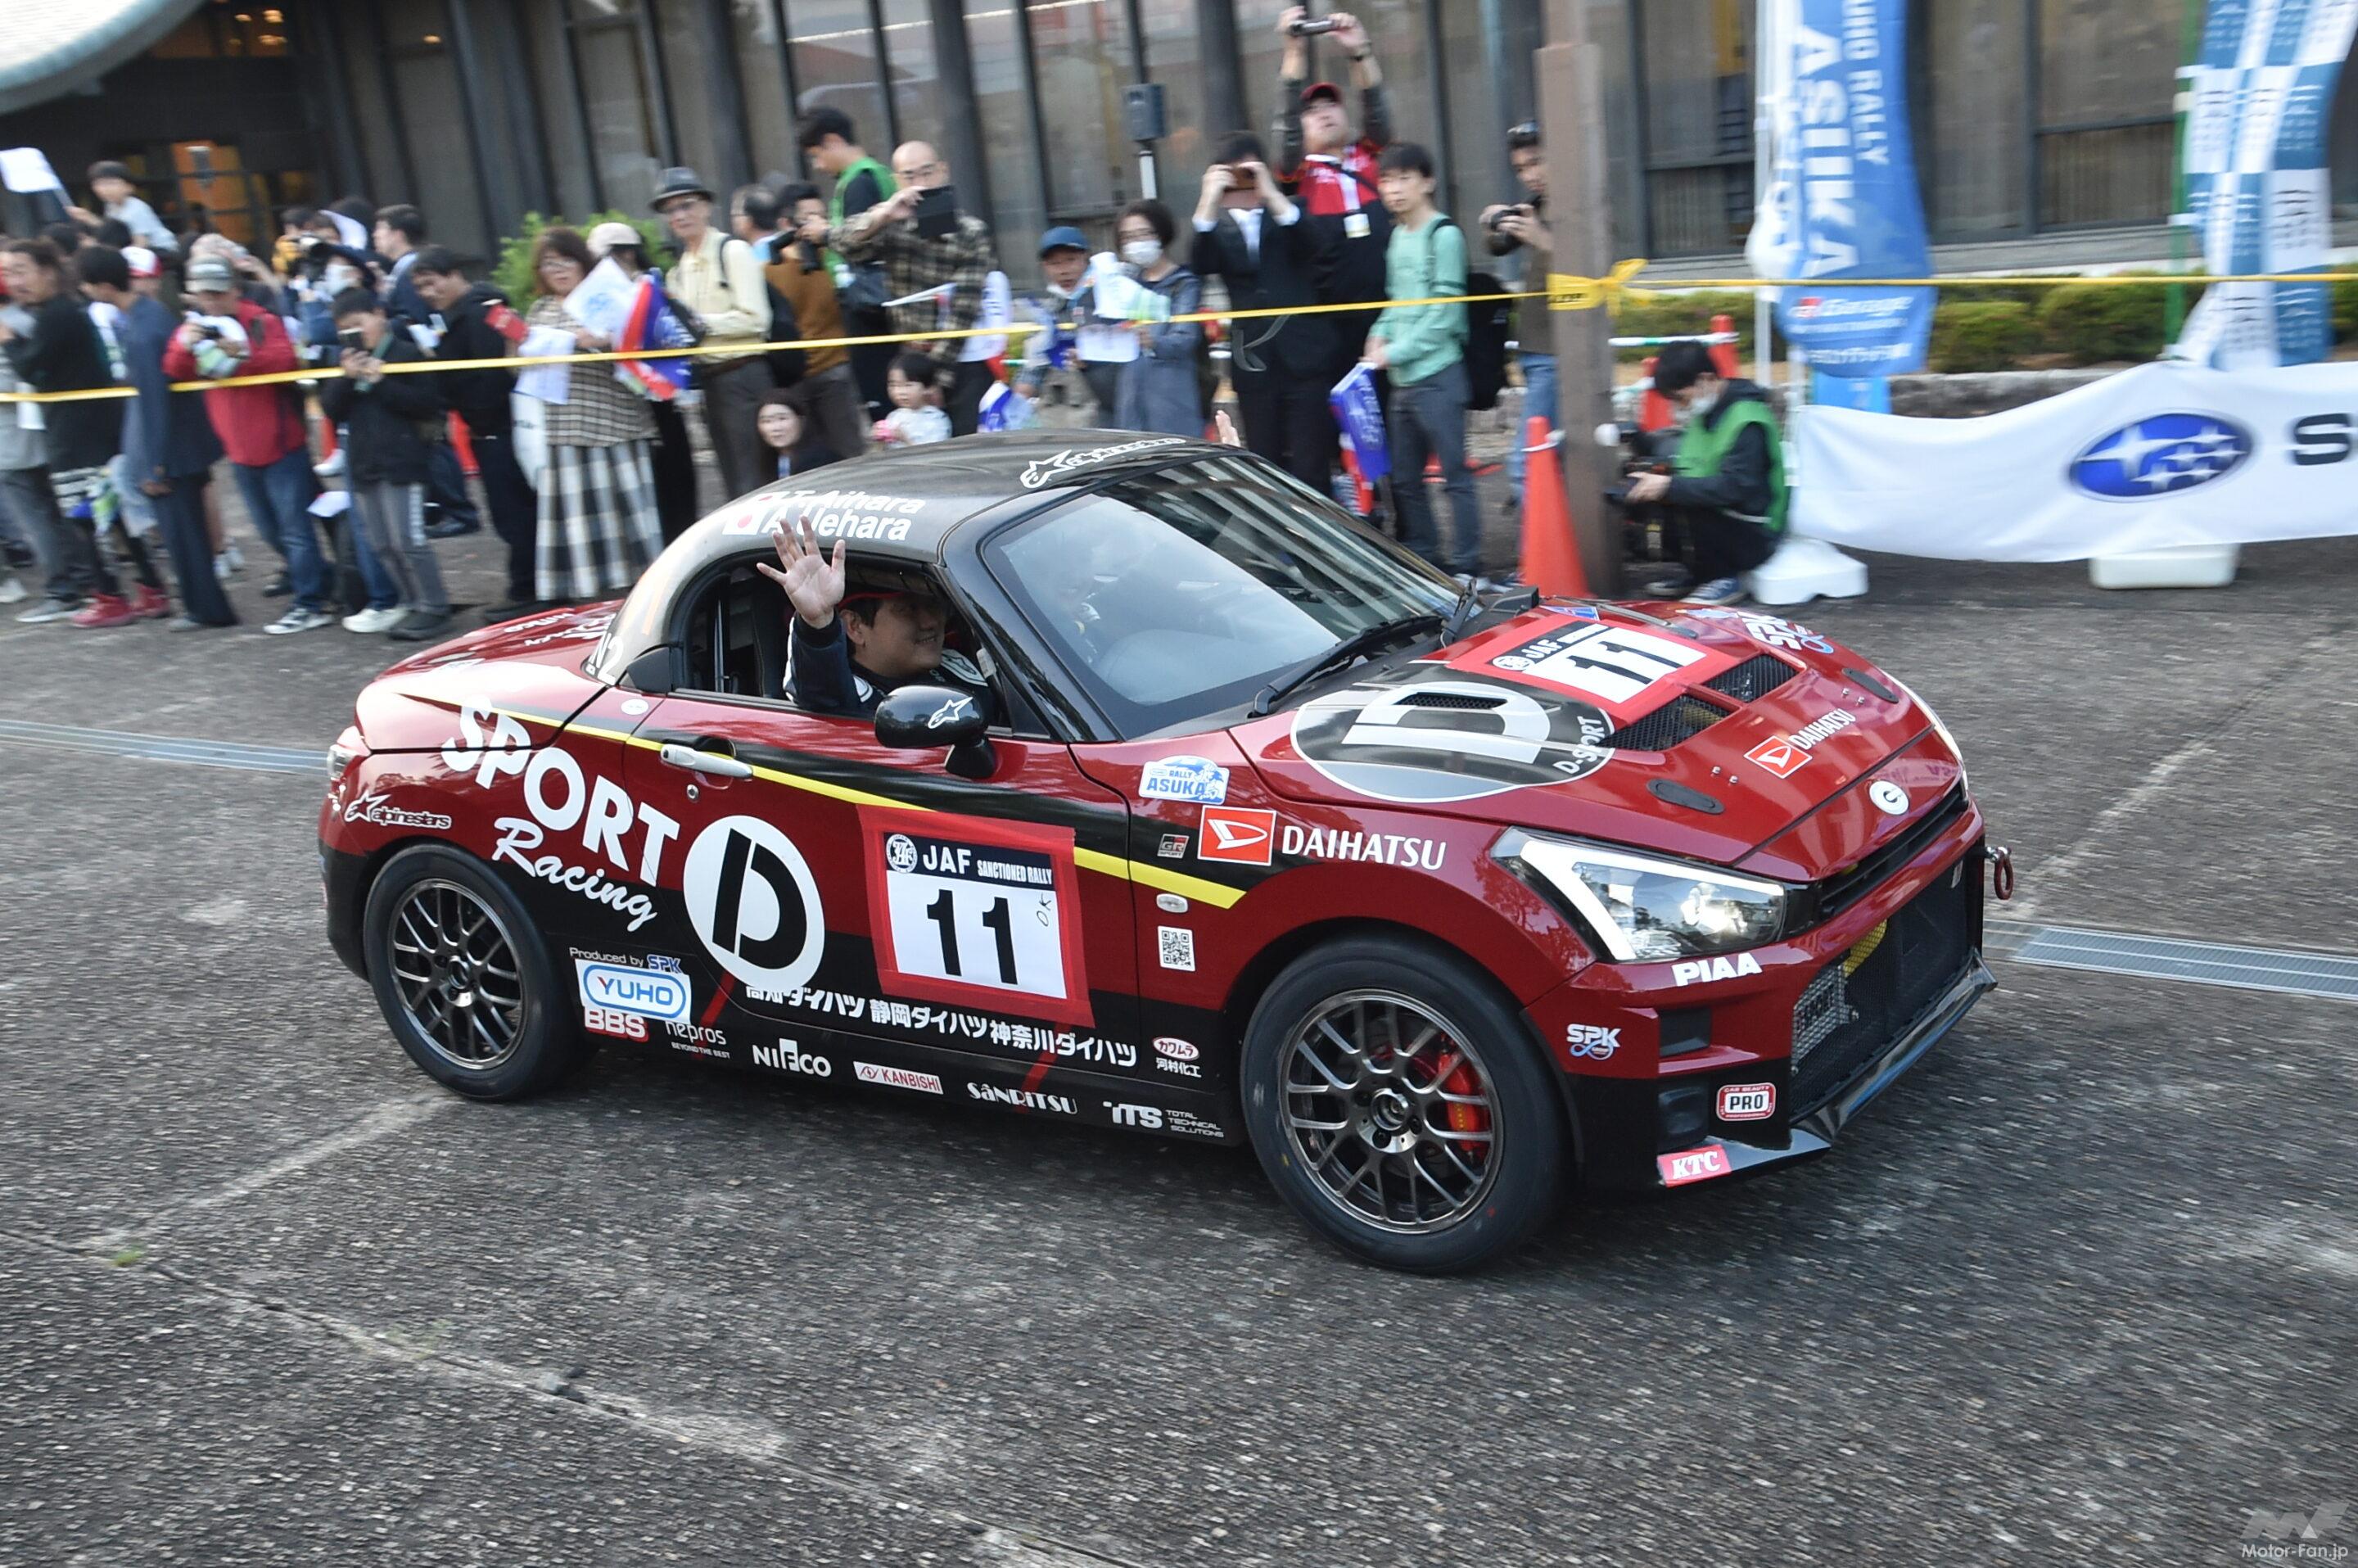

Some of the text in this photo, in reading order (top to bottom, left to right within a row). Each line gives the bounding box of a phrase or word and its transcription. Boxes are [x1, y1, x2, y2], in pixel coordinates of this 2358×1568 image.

[1846, 69, 1890, 165] RALLY
[1794, 25, 1859, 279] ASUKA
[2290, 413, 2351, 466] S
[1521, 639, 1563, 659] JAF
[1565, 640, 1684, 685] 11
[1789, 708, 1856, 751] DAIHATSU
[1553, 716, 1606, 774] D-SPORT
[1146, 777, 1206, 796] ASUKA
[1169, 770, 1192, 778] RALLY
[440, 694, 680, 887] SPORT
[371, 806, 453, 829] alpinestars
[1161, 841, 1185, 852] GR
[1281, 825, 1447, 871] DAIHATSU
[491, 816, 657, 932] Racing
[923, 844, 1052, 885] JAF SANCTIONED RALLY
[927, 888, 1019, 985] 11
[569, 947, 683, 973] Produced by SPK
[1671, 952, 1763, 987] PIAA
[597, 976, 674, 1006] YUHO
[585, 1008, 648, 1041] BBS
[665, 1020, 727, 1046] nepros
[1566, 1023, 1622, 1047] SPK
[671, 1042, 730, 1060] BEYOND THE BEST
[752, 1037, 832, 1078] NIFCO
[989, 1021, 1137, 1067] 神奈川ダイハツ
[1158, 1040, 1194, 1057] カワムラ
[883, 1070, 942, 1092] KANBISHI
[1165, 1109, 1198, 1120] TOTAL
[1730, 1094, 1764, 1110] PRO
[1167, 1117, 1222, 1131] TECHNICAL
[1170, 1125, 1224, 1138] SOLUTIONS
[1672, 1150, 1723, 1180] KTC
